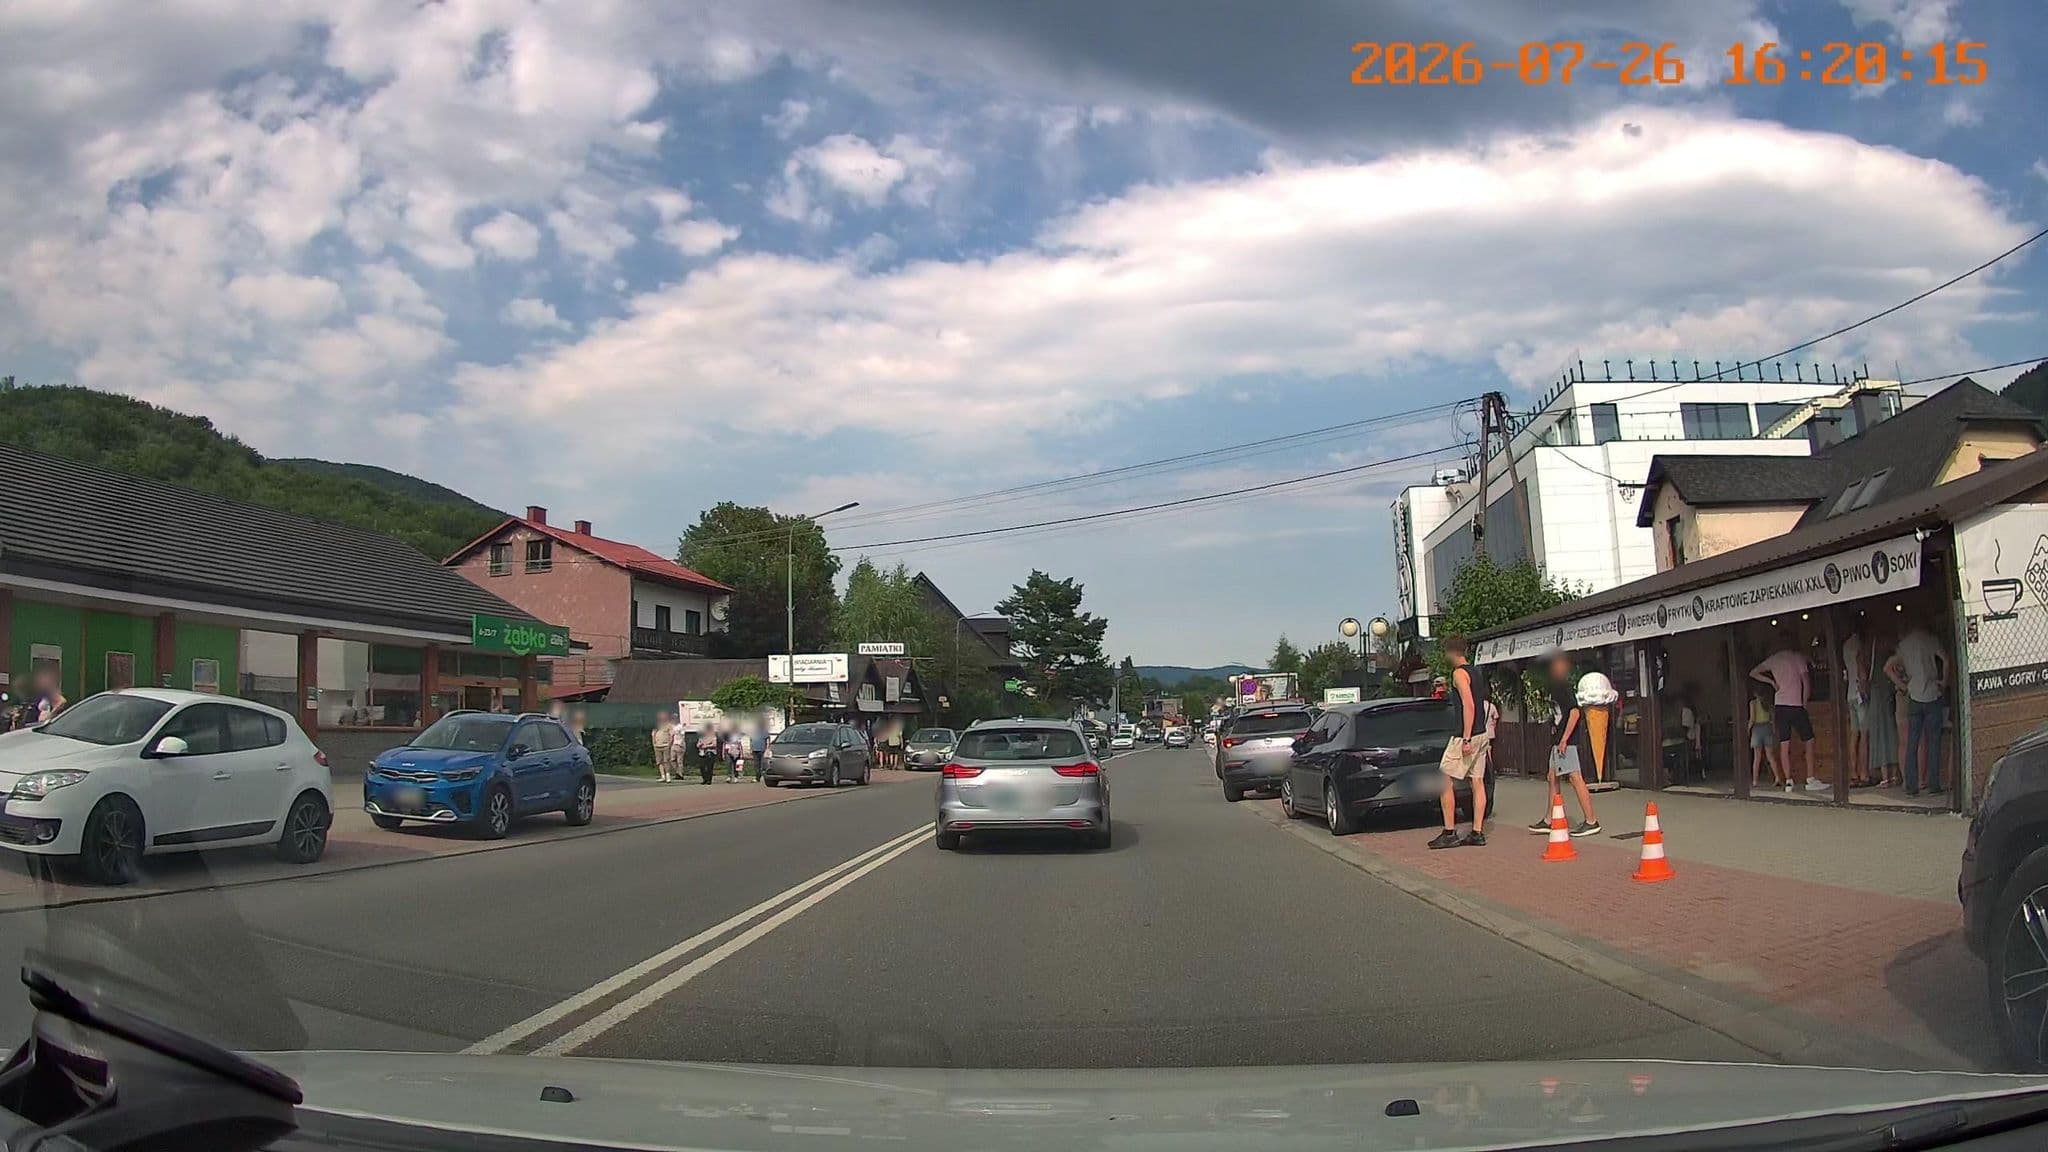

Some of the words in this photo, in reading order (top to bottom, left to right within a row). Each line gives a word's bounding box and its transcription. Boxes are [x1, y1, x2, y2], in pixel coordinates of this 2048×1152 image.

[1667, 605, 1692, 621] FRYTKI
[1705, 592, 1749, 612] KRAFTOWE
[1750, 579, 1803, 604] ZAPIEKANKI
[1806, 575, 1825, 593] XXL
[1842, 563, 1871, 585] PIWO
[1890, 551, 1917, 573] SOKI
[1976, 675, 2003, 691] KAWA
[2008, 670, 2037, 686] GOFRY
